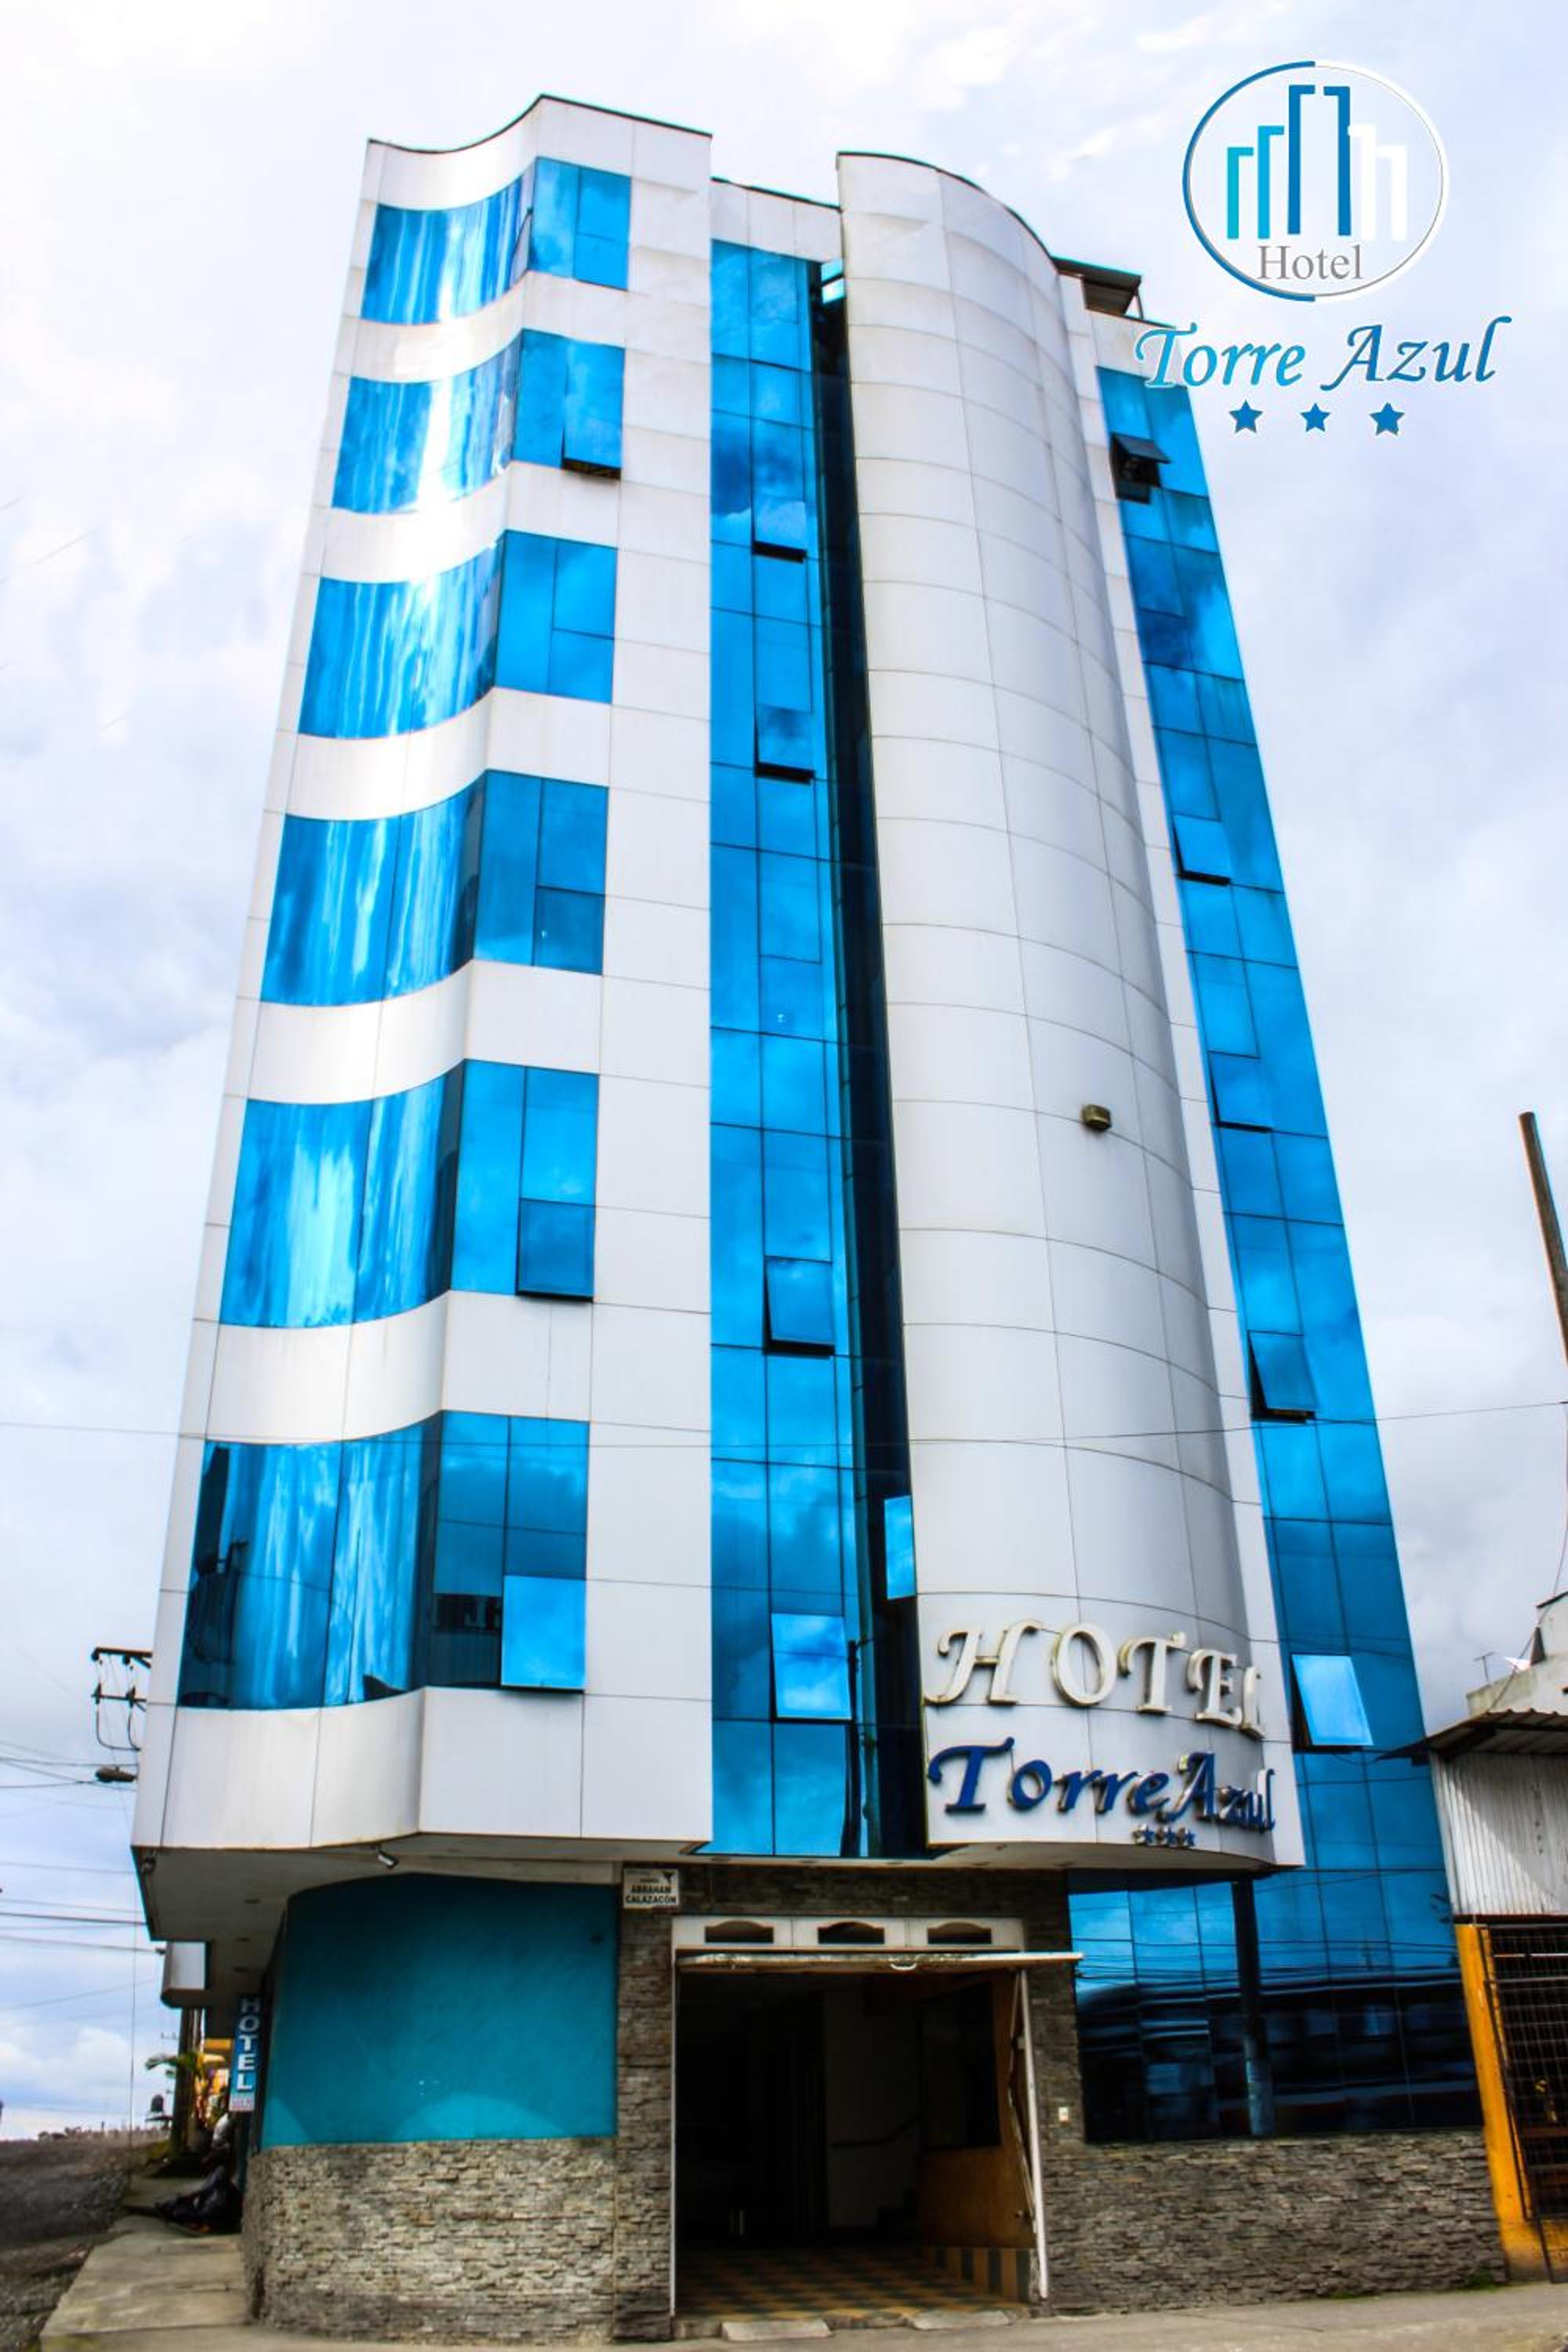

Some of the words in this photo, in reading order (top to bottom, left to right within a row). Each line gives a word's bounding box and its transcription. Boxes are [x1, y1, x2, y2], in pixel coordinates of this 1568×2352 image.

[924, 1619, 1265, 1740] HOTEL
[927, 1737, 1170, 1817] Torre
[1155, 1751, 1276, 1832] Azul
[237, 1998, 260, 2092] HOTEL
